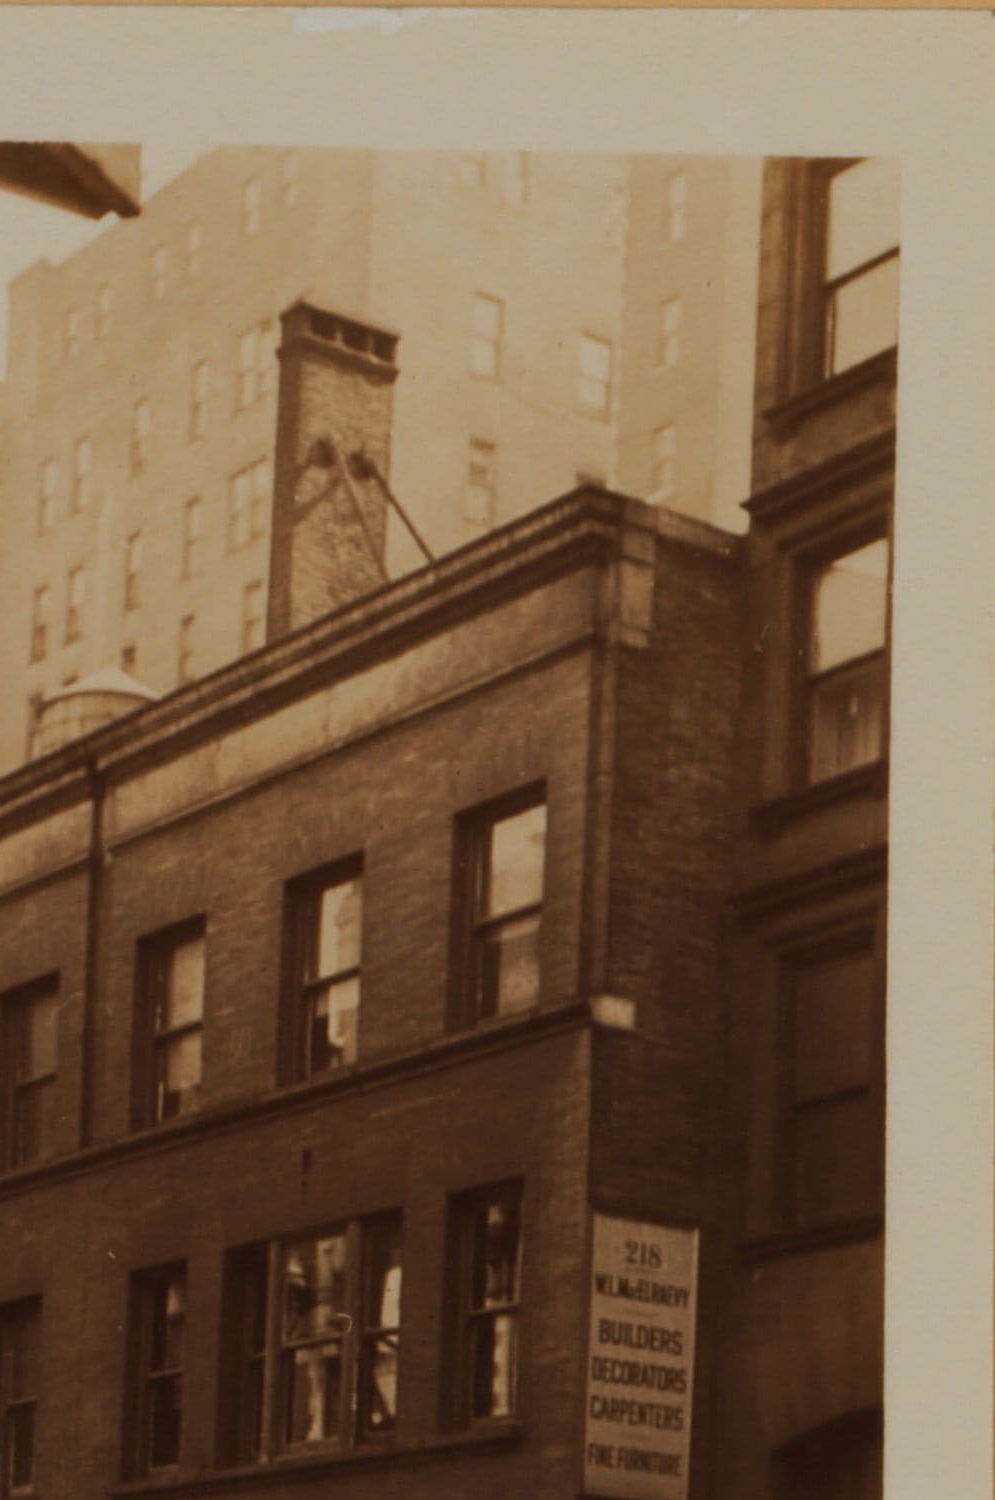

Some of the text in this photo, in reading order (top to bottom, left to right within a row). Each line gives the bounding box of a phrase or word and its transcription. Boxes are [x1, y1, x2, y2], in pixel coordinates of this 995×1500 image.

[625, 1240, 662, 1269] 218
[599, 1318, 684, 1356] BUILDERS
[591, 1356, 687, 1394] DECORATORS
[590, 1394, 685, 1431] CARPENTERS
[588, 1442, 682, 1476] FINE FURNITURE
